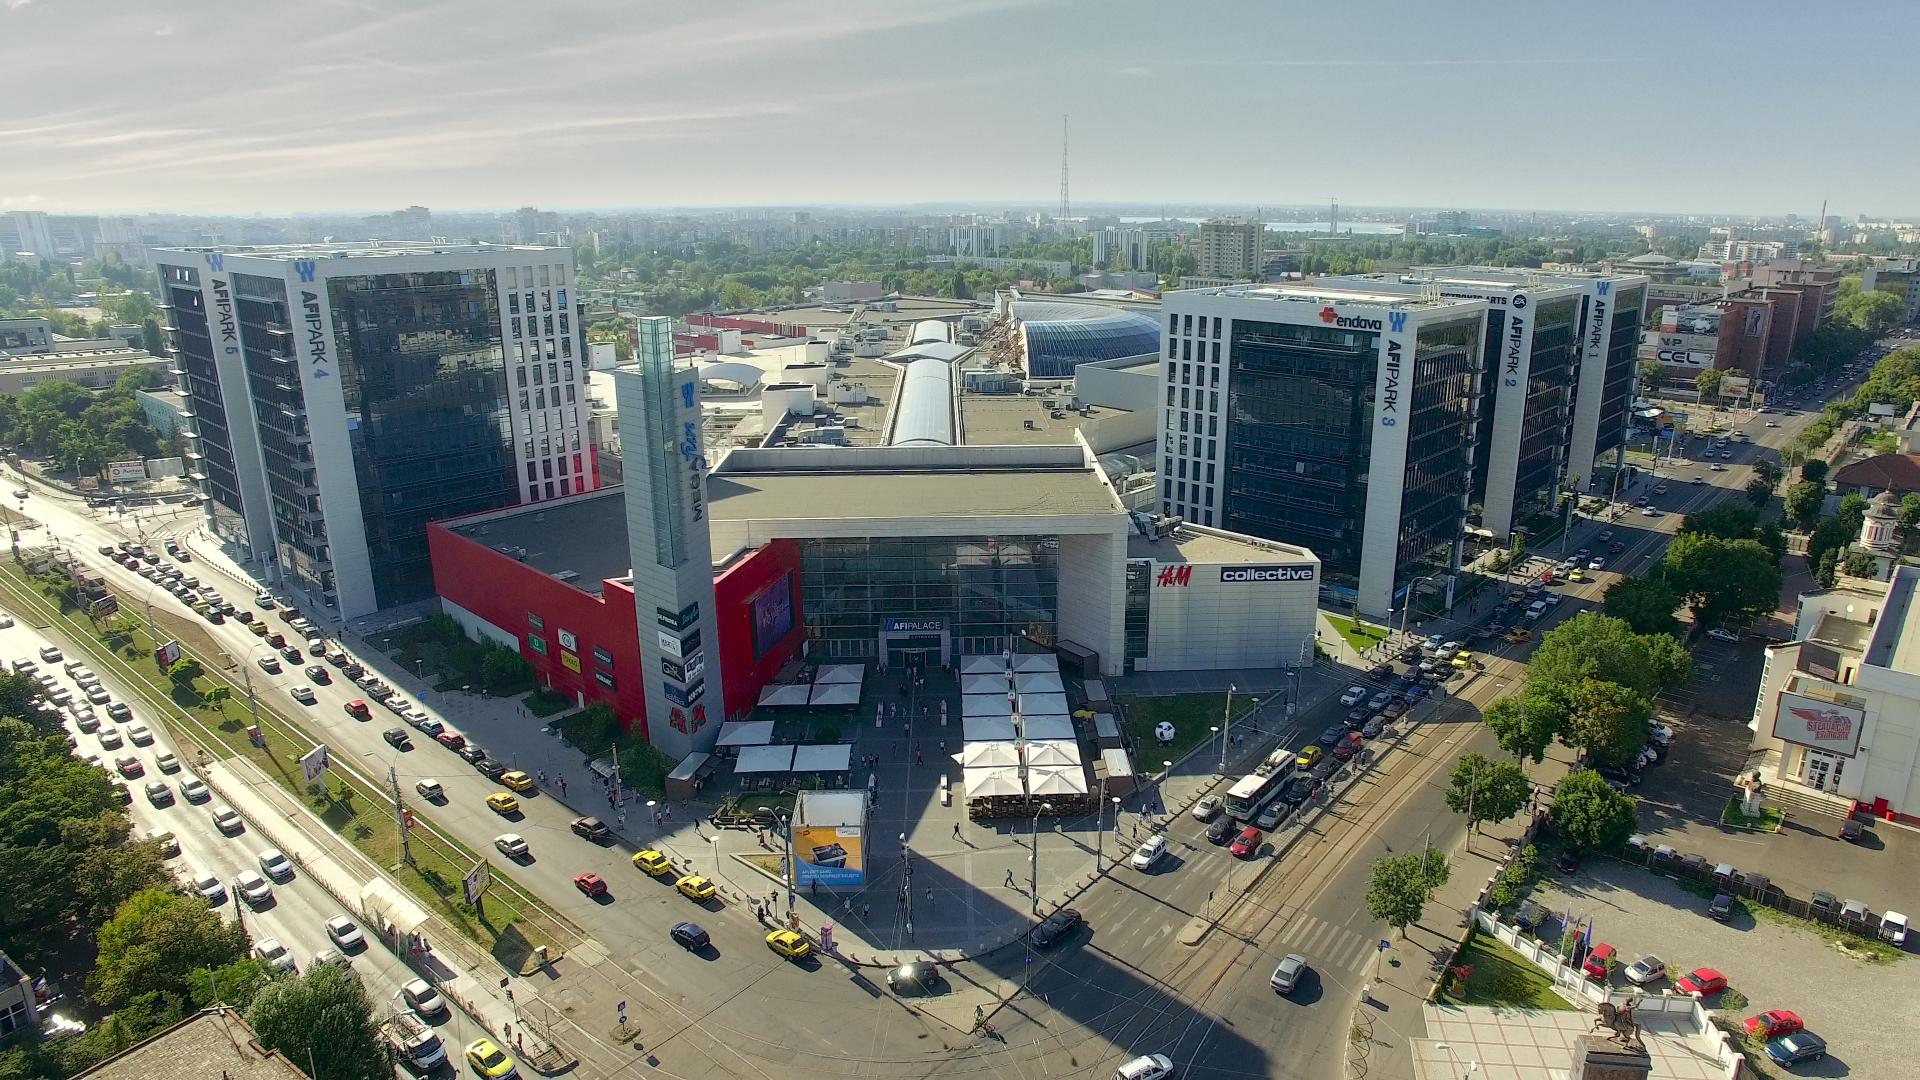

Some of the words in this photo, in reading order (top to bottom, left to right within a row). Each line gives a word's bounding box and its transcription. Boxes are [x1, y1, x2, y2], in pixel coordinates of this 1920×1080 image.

[301, 291, 327, 364] AFIPARK
[1336, 315, 1382, 330] endava
[1590, 300, 1605, 349] AFIPARK
[1506, 316, 1524, 375] AFIPARK
[1383, 339, 1401, 413] AFIPARK
[1504, 378, 1517, 388] 2
[1382, 417, 1396, 427] 3
[1156, 565, 1193, 588] H&M
[1222, 567, 1313, 582] collective
